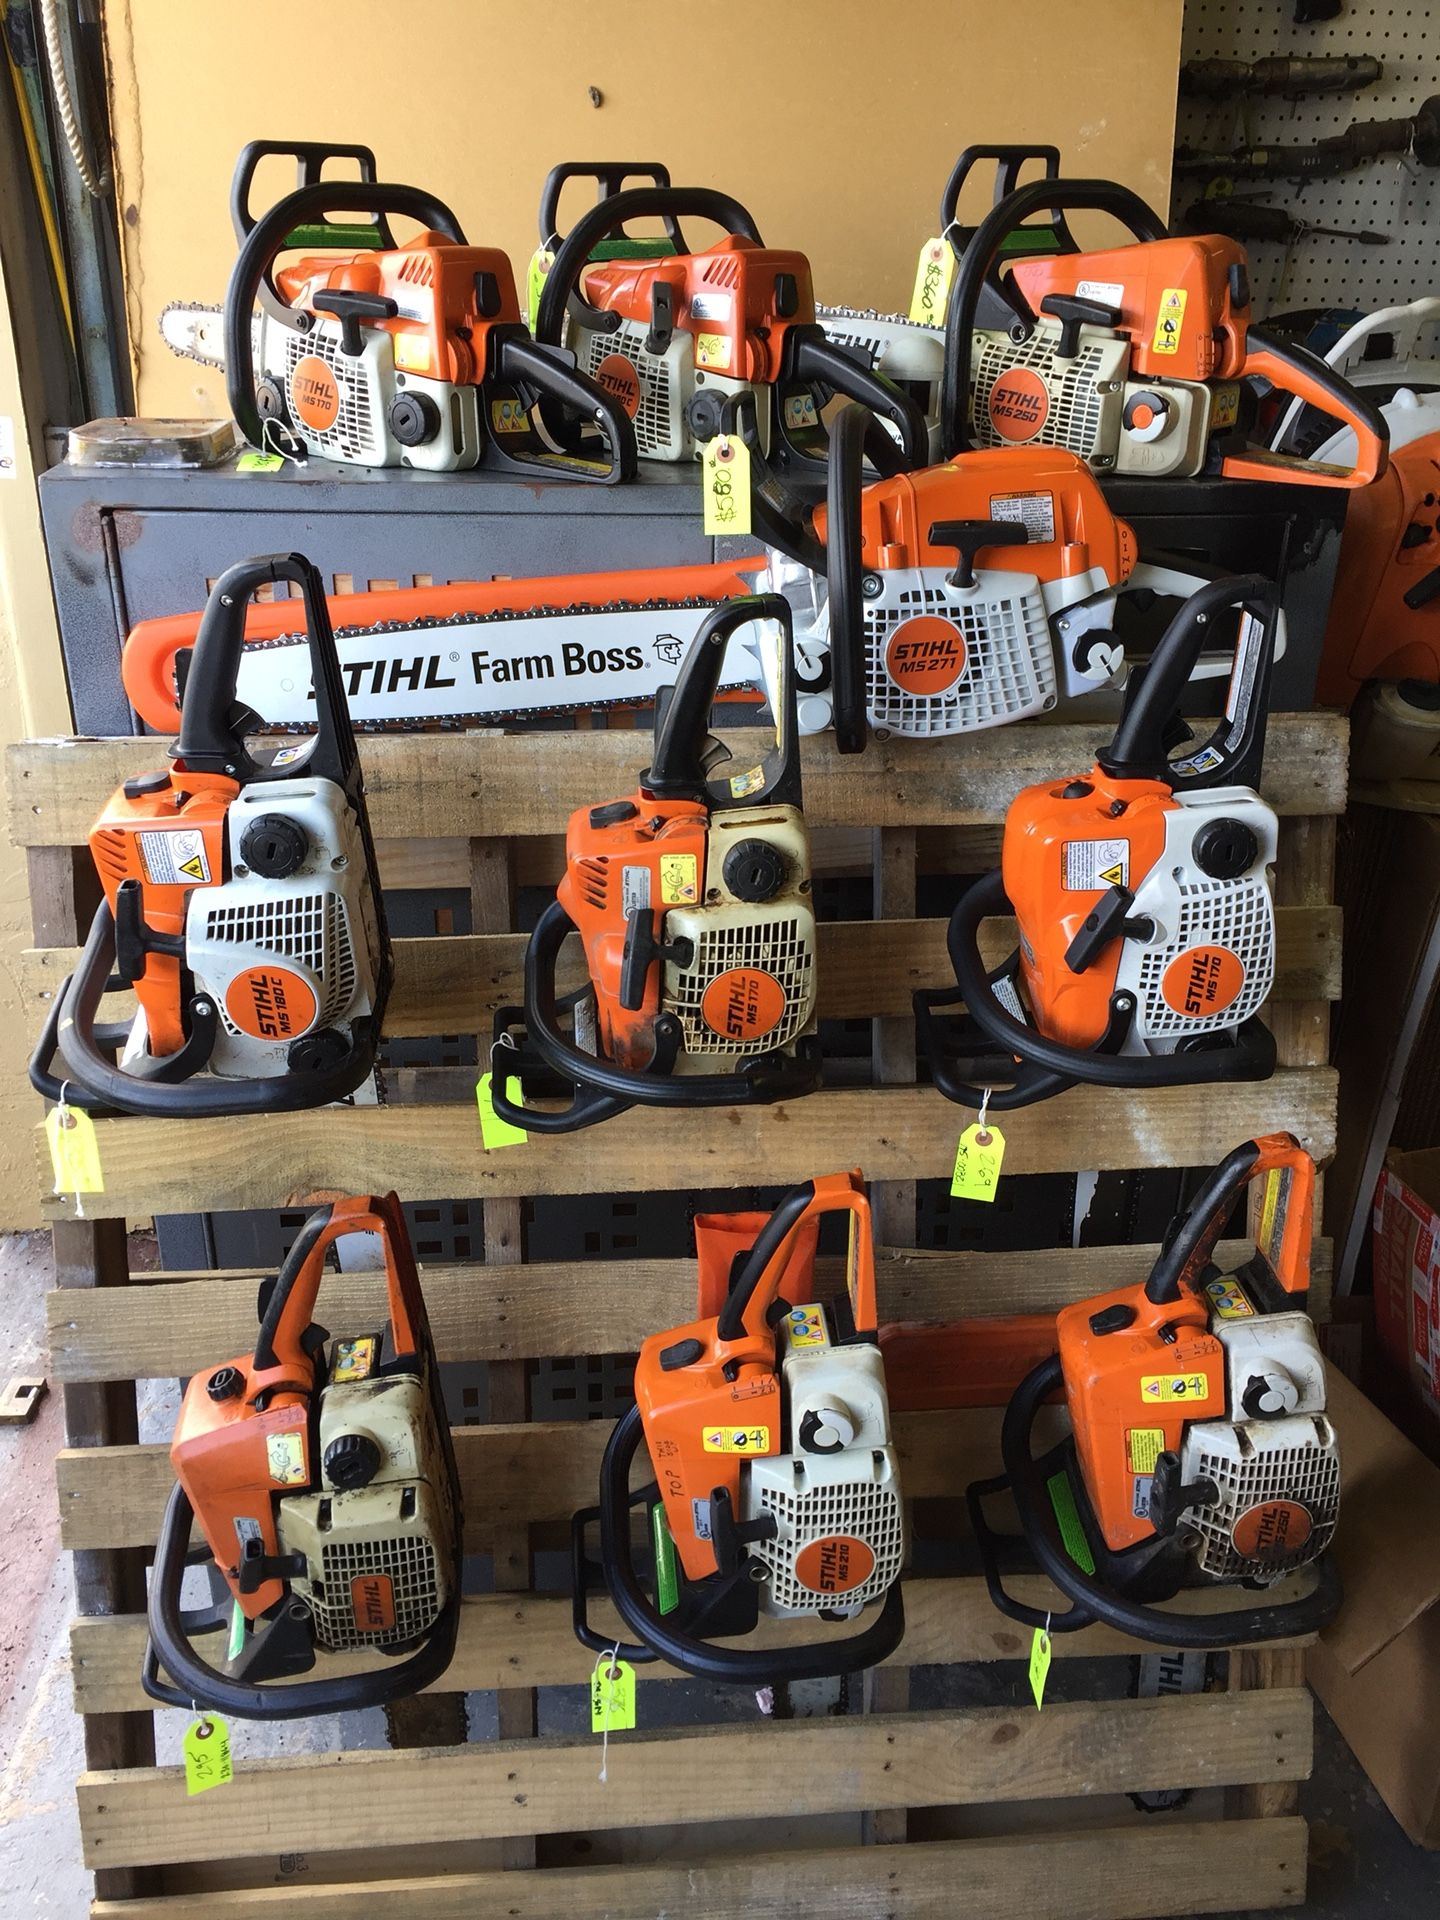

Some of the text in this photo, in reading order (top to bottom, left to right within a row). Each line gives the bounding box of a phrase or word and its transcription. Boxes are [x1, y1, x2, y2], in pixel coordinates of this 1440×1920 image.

[825, 330, 881, 363] TIHL
[294, 375, 334, 399] STIHL
[598, 373, 635, 396] STIHL
[994, 388, 1042, 411] STIHL
[306, 642, 645, 700] TIHL Farm Boss
[894, 640, 958, 660] STIHL
[1185, 953, 1210, 1014] STIHL
[251, 974, 278, 1037] STIHL
[727, 976, 748, 1037] STIHL
[665, 1470, 684, 1497] TOP
[820, 1542, 837, 1591] STIHL
[364, 1581, 384, 1625] STIHL
[1158, 1652, 1185, 1695] IHL
